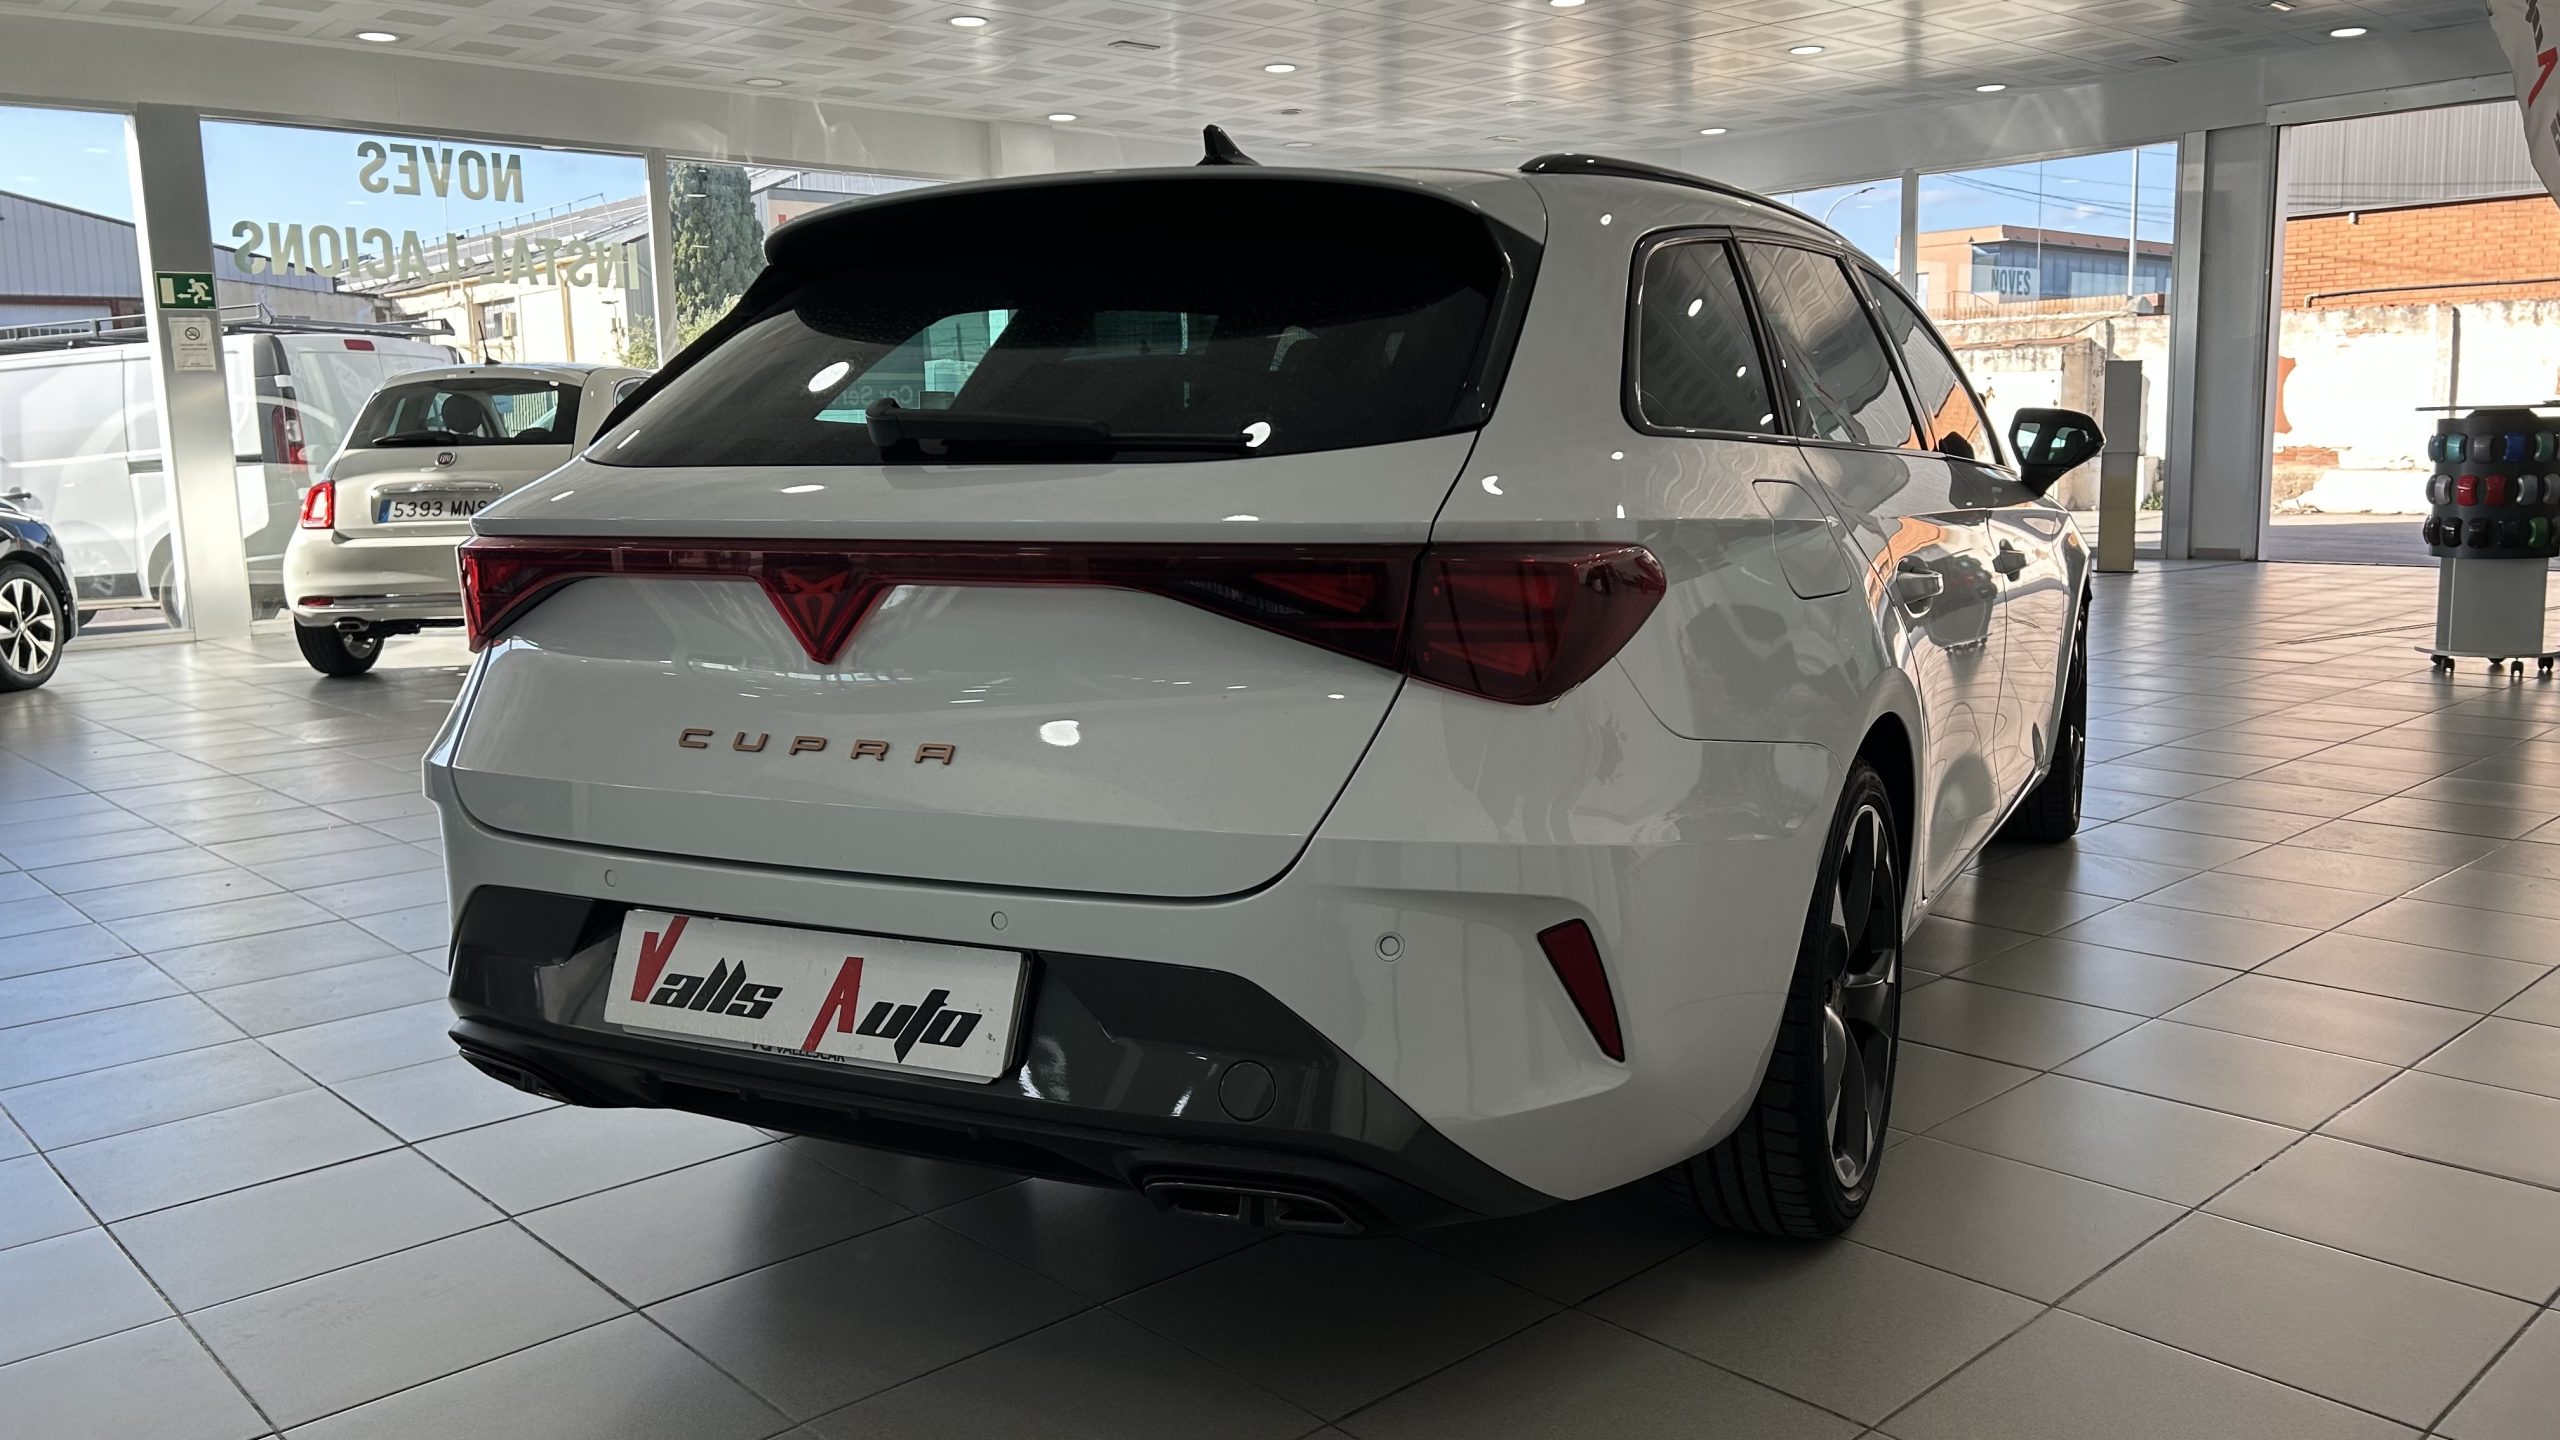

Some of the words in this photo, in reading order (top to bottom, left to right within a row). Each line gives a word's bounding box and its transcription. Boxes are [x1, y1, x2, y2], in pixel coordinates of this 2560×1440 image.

[1991, 269, 2031, 296] NOVES
[393, 501, 443, 518] 5393
[678, 728, 955, 765] CUPRA
[631, 915, 783, 1019] Valls
[801, 957, 983, 1063] Auto
